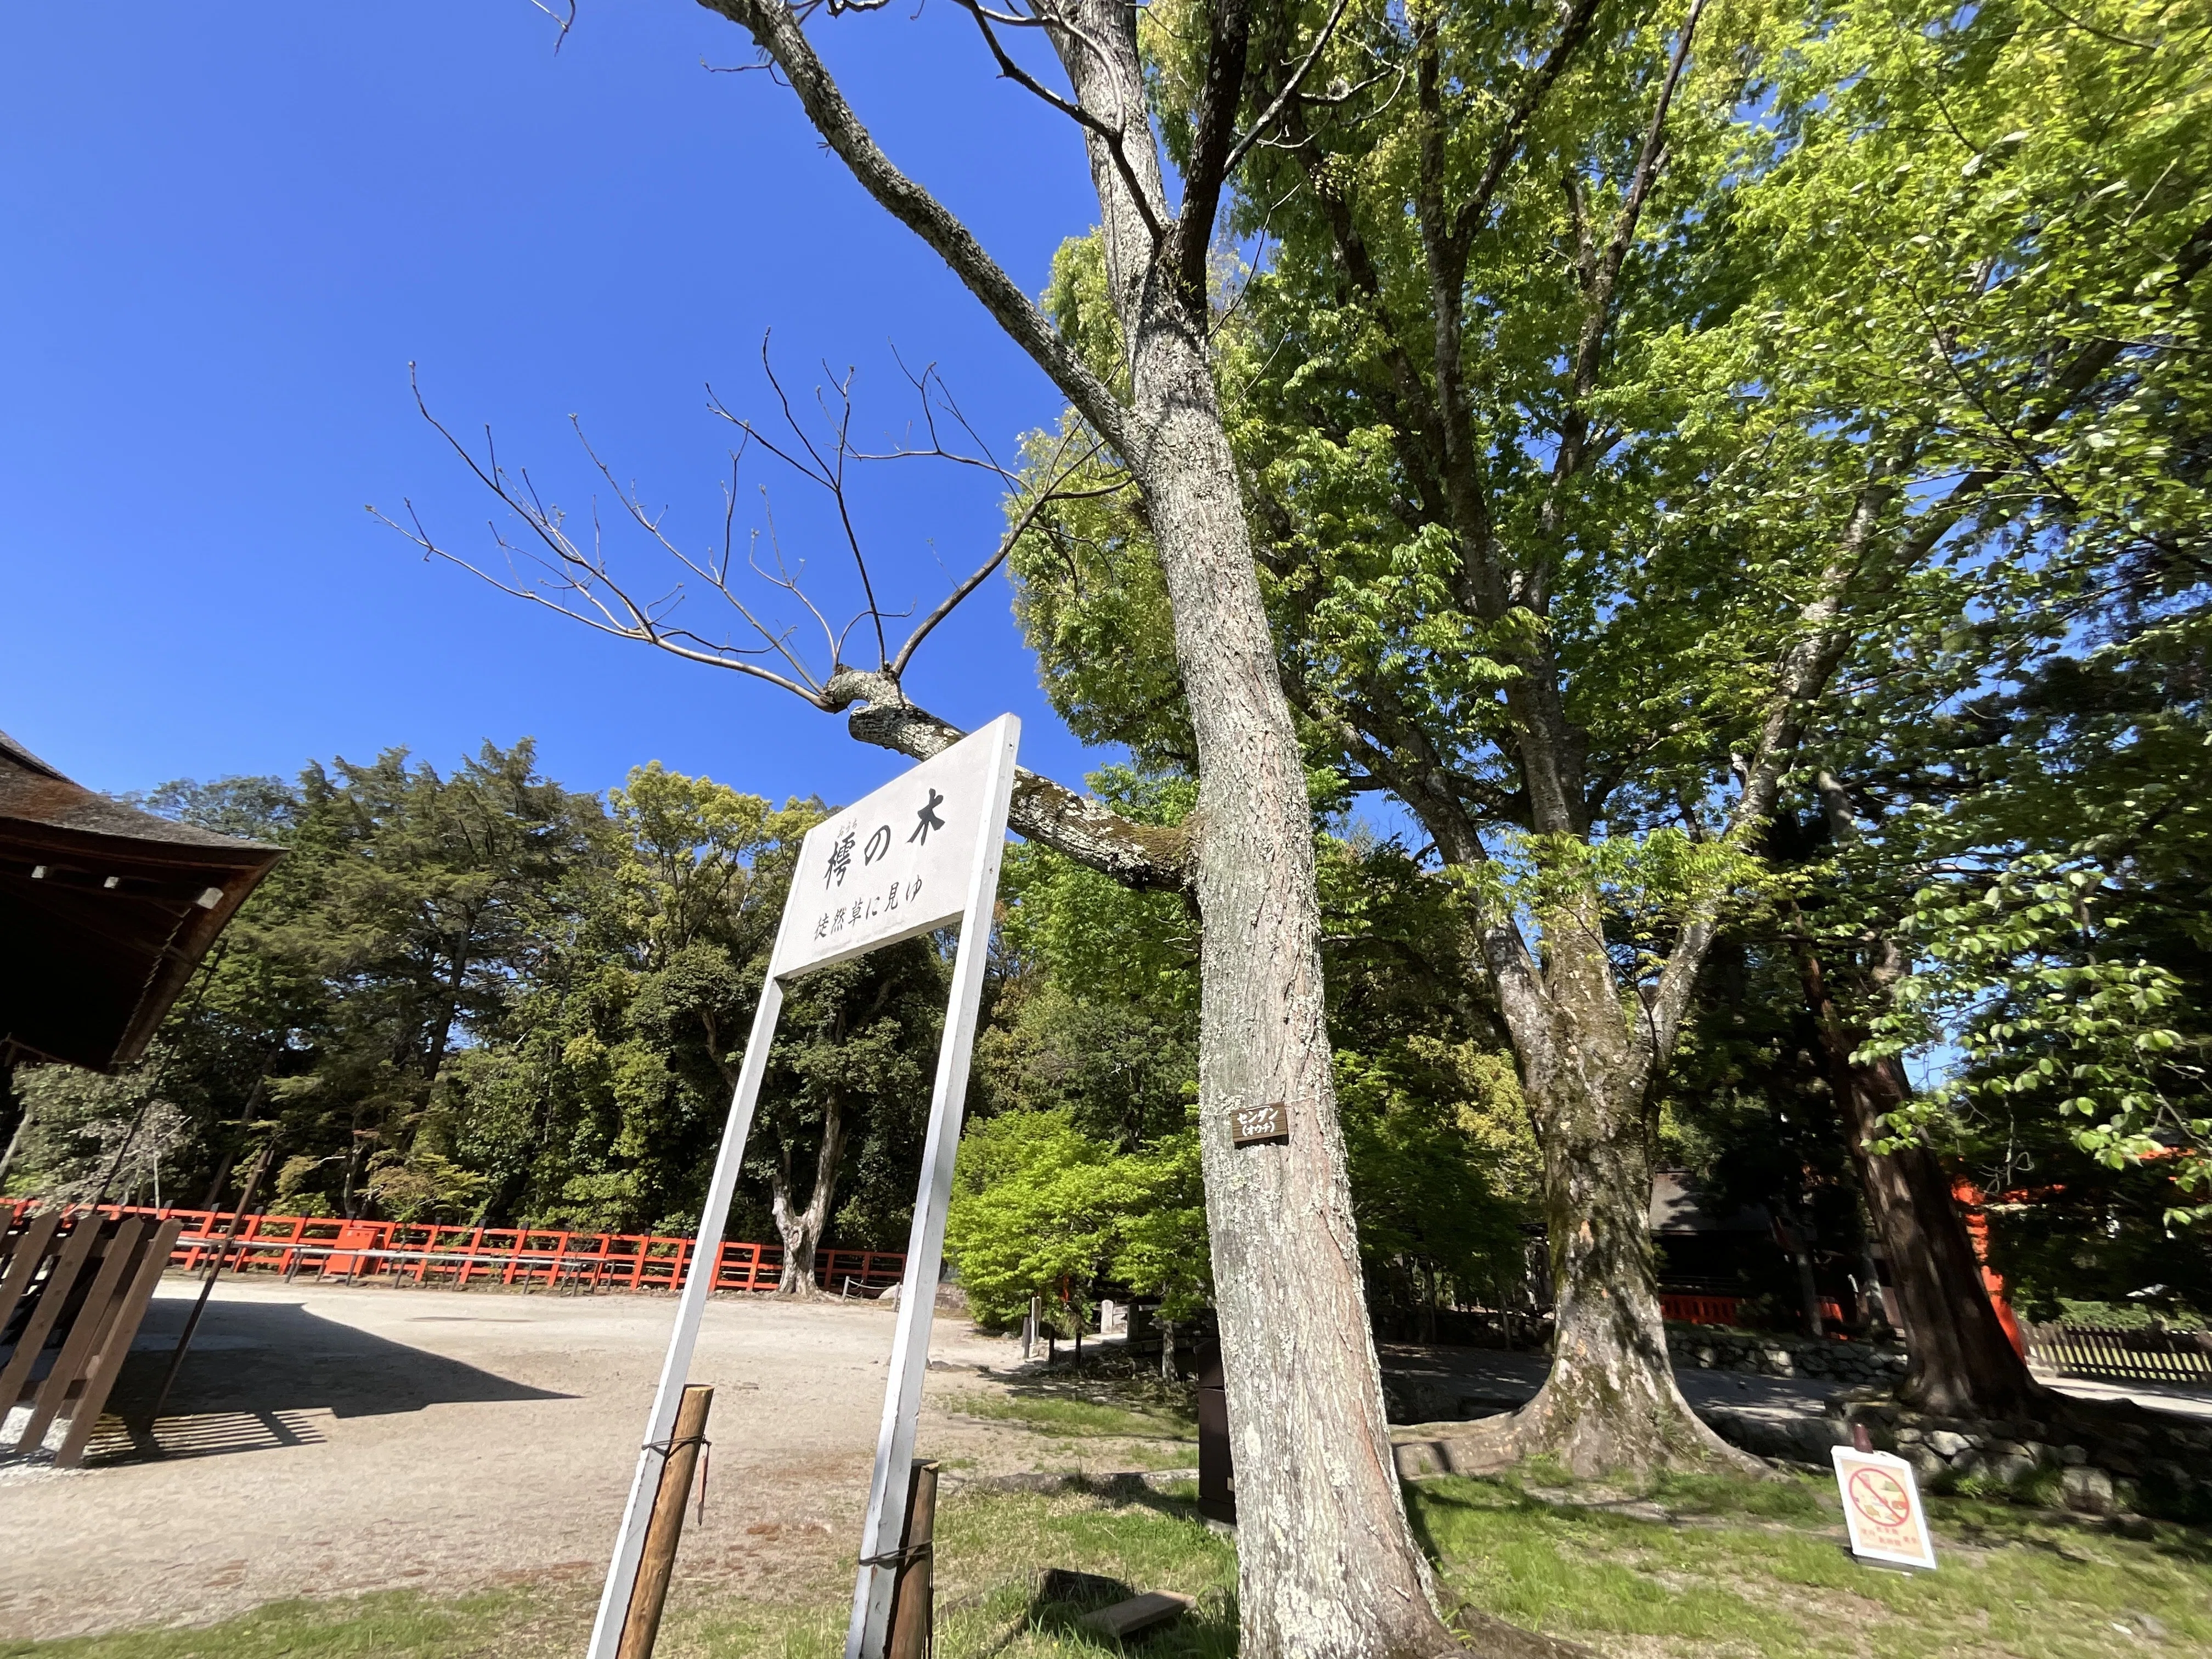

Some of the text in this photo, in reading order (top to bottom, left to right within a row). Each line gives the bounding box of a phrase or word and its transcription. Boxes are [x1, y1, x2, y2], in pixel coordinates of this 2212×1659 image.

[814, 874, 922, 941] 徒然草に見ゆ
[1237, 1108, 1278, 1125] センダン
